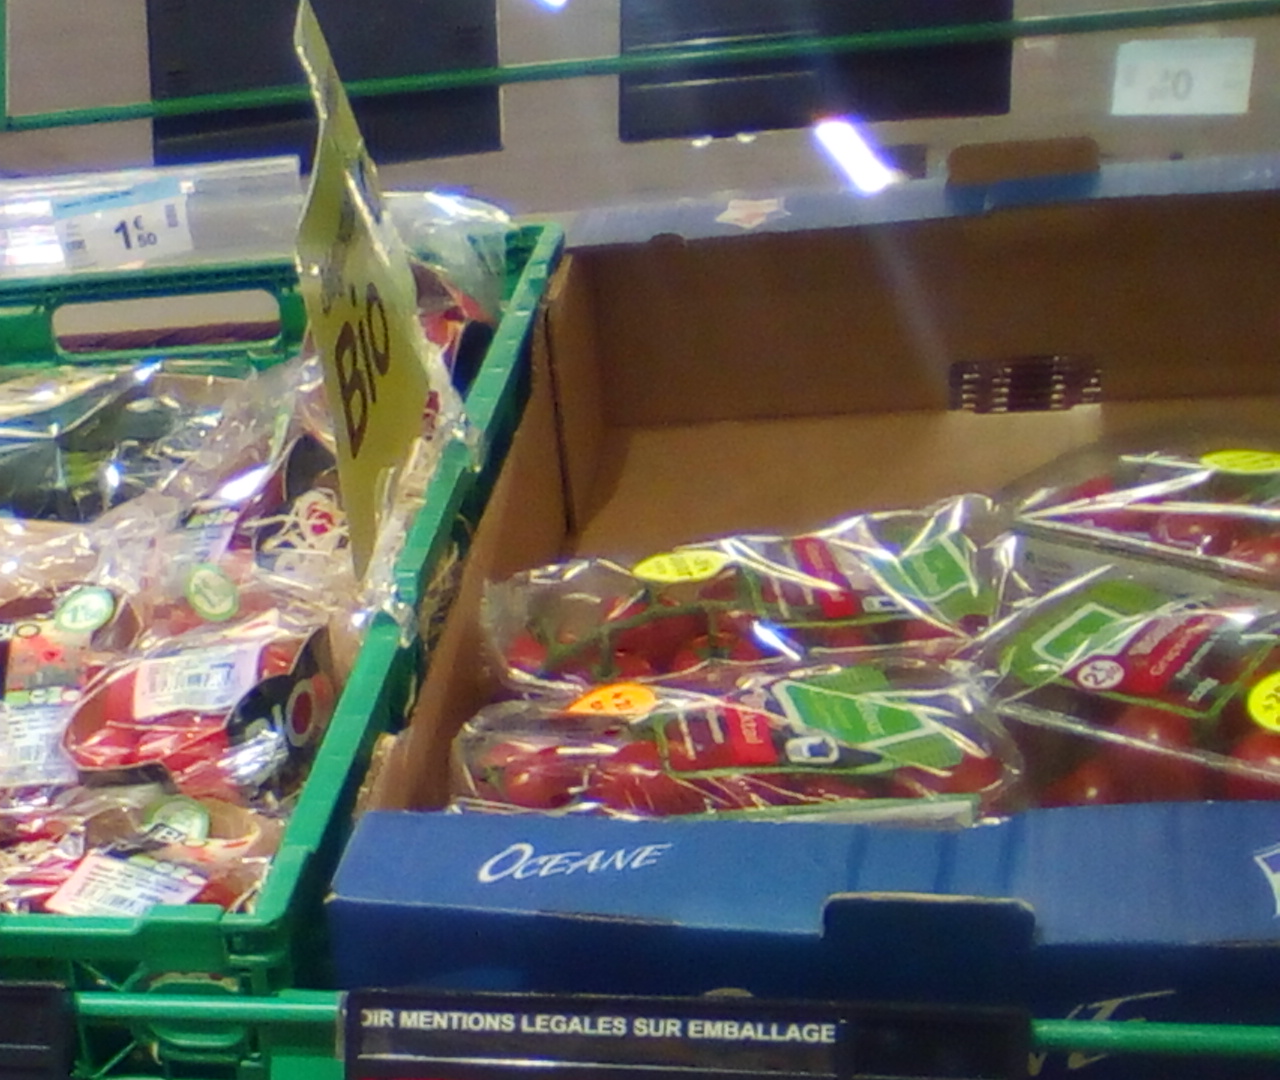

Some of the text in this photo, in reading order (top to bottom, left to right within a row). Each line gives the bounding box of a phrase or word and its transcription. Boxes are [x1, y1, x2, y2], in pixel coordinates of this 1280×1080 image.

[335, 282, 391, 459] Bio
[400, 1010, 516, 1033] MENTIONS
[521, 1012, 628, 1037] LEGALES
[633, 1017, 682, 1039] SUR
[687, 1019, 837, 1044] EMBALLAGE
